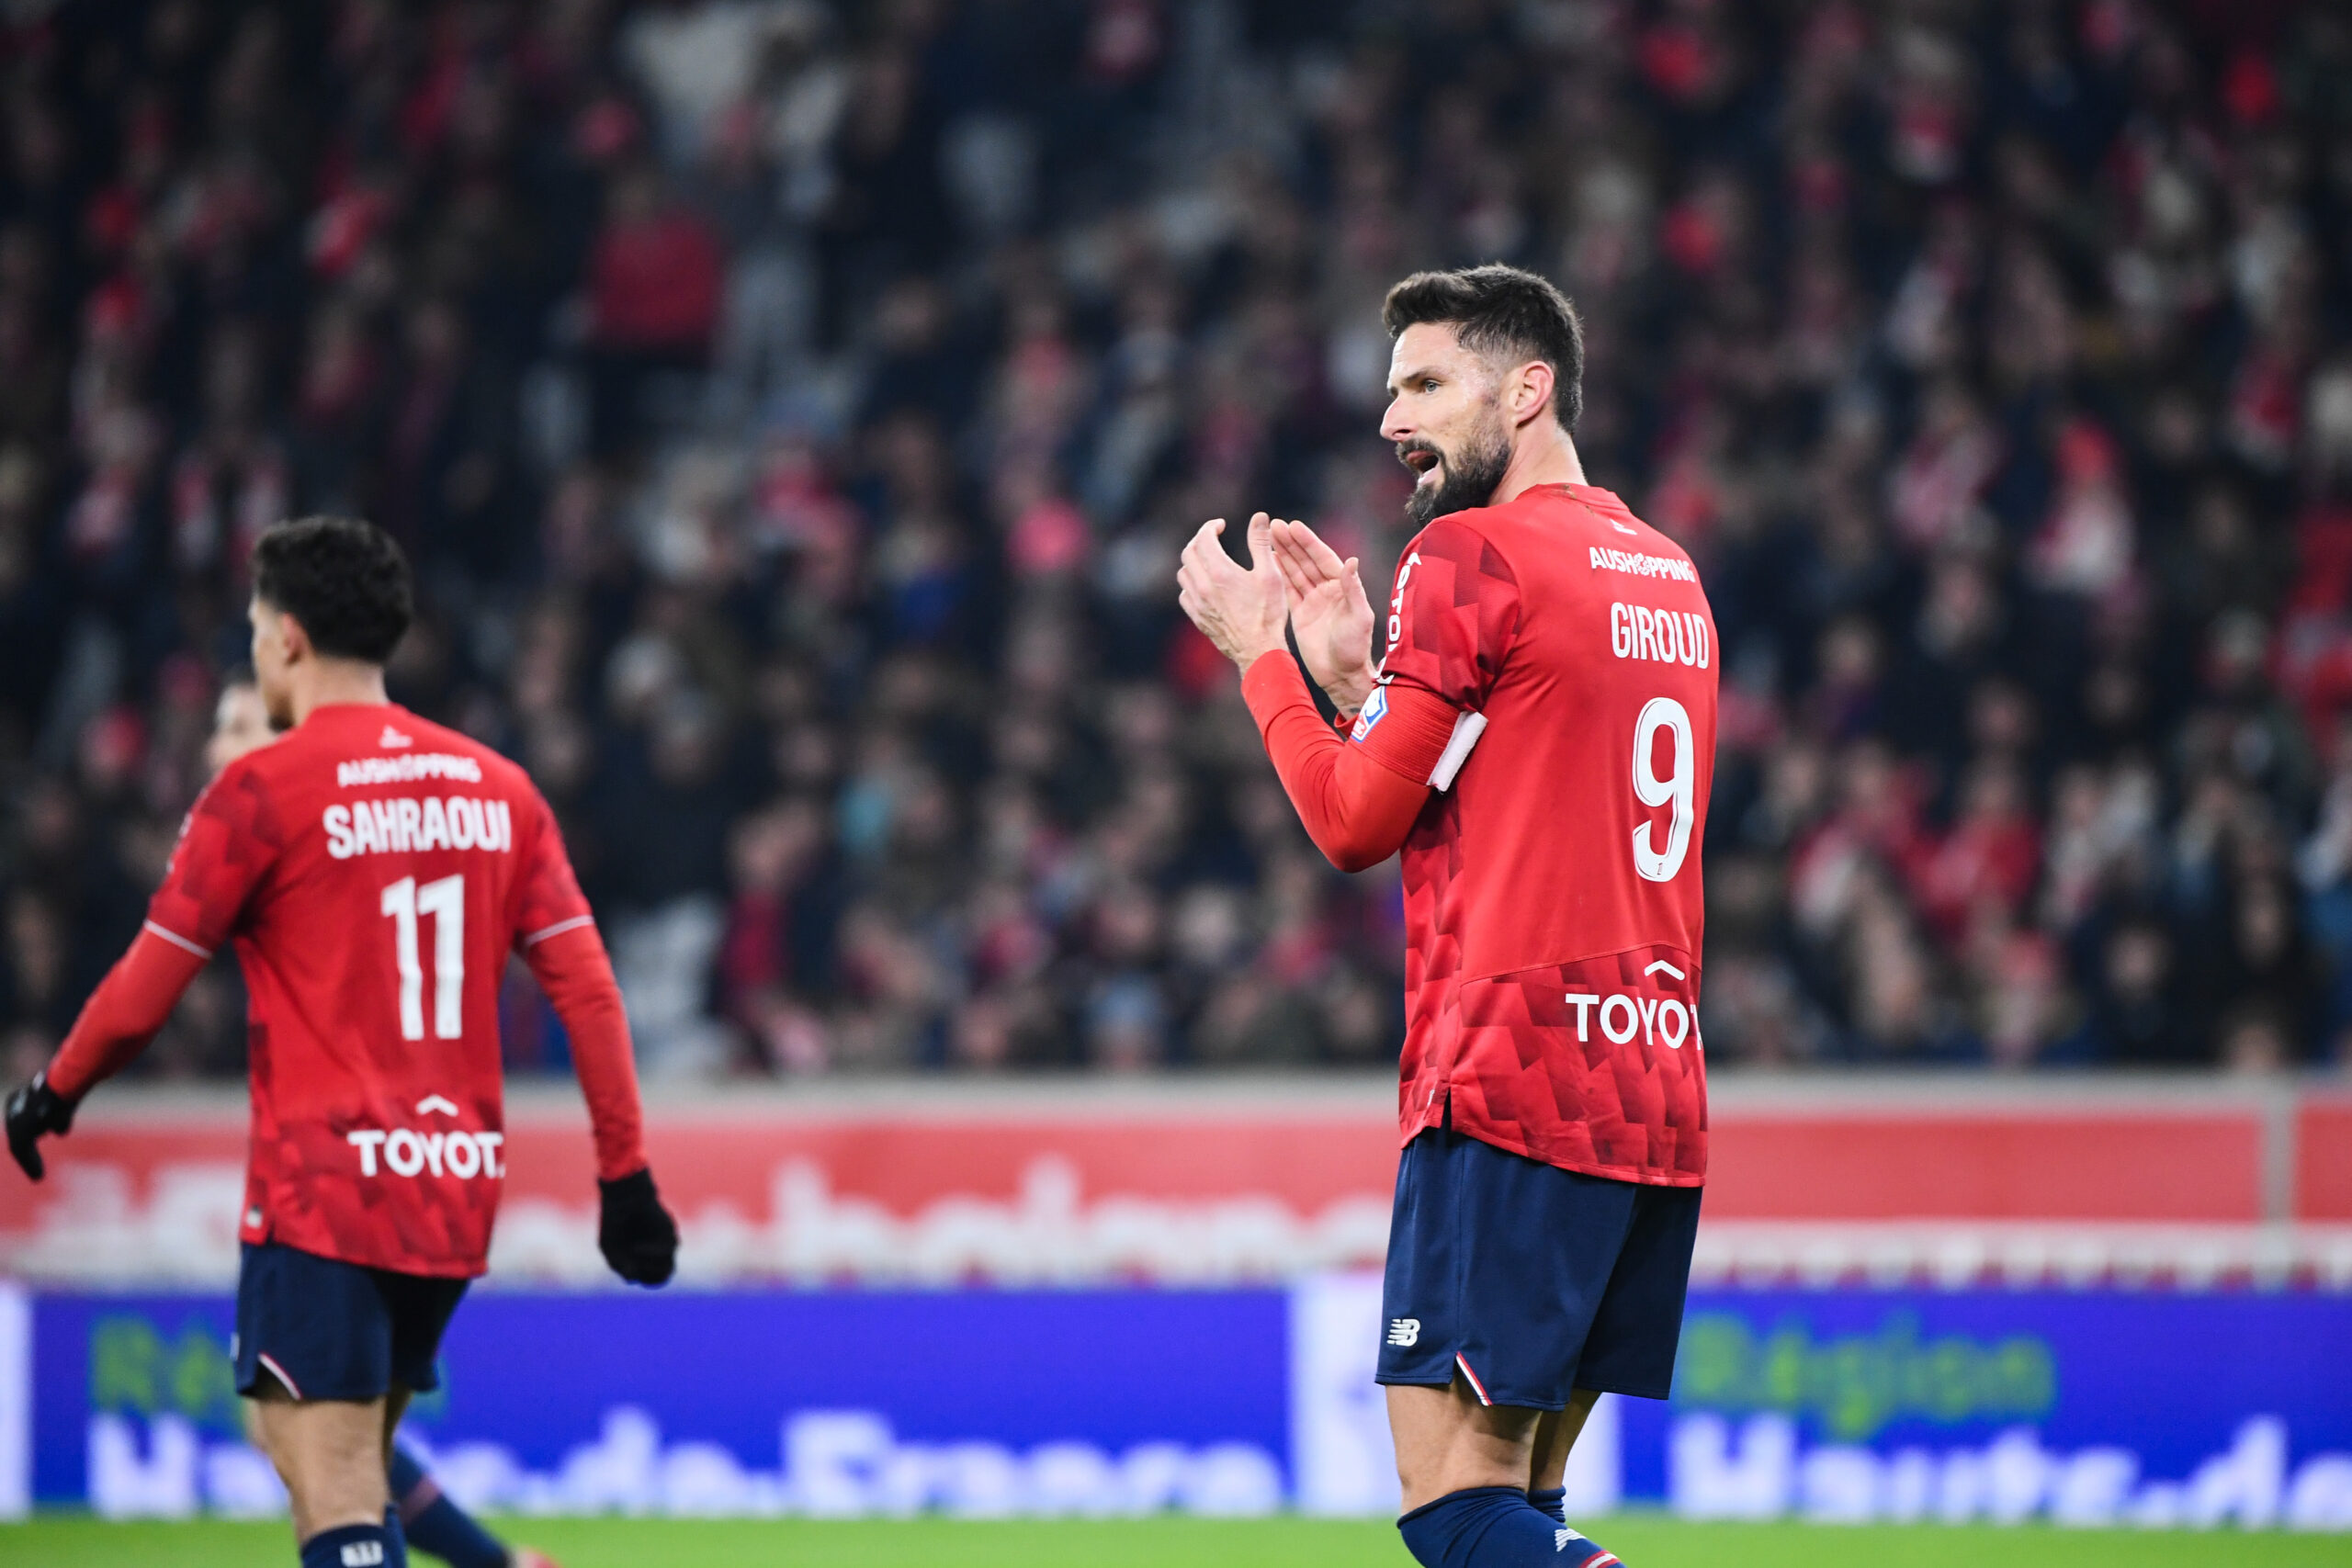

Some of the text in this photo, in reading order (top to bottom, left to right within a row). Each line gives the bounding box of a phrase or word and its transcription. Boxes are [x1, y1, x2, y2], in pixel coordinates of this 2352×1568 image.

[1589, 547, 1696, 582] AUSHOPPING
[1611, 602, 1710, 670] GIROUD
[1632, 696, 1695, 883] 9
[322, 795, 512, 860] SAHRAOUI
[380, 874, 465, 1042] 11
[1565, 993, 1703, 1051] TOYO
[346, 1128, 505, 1179] TOYOT
